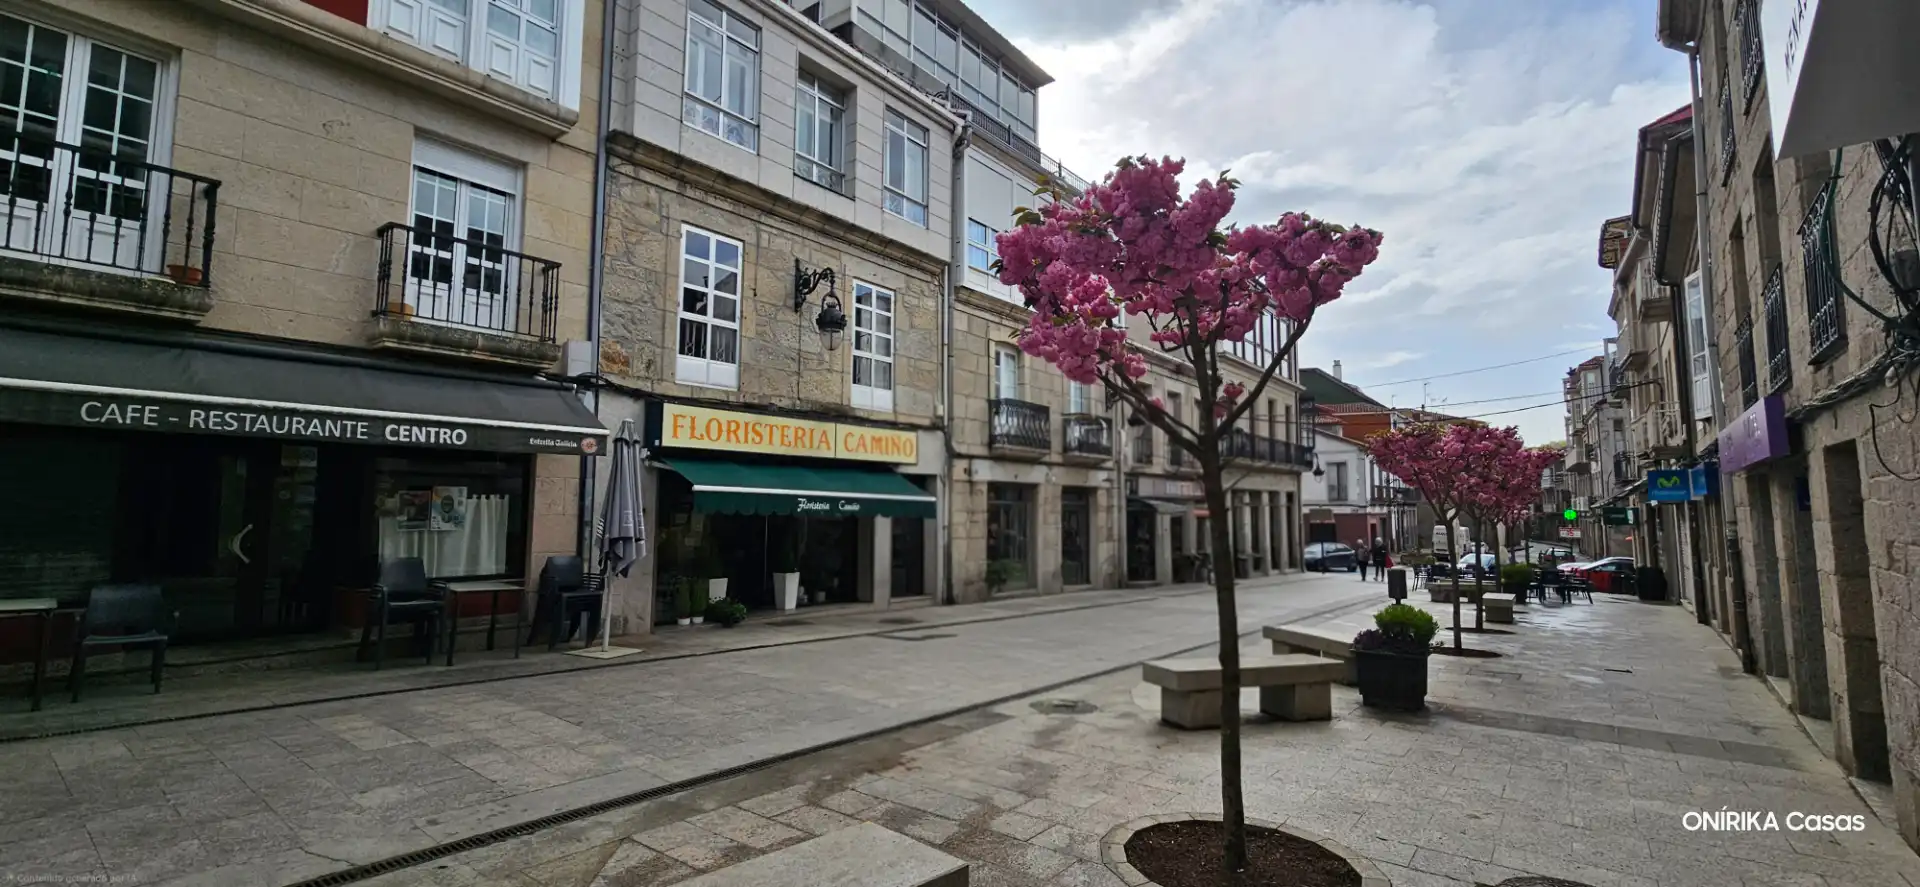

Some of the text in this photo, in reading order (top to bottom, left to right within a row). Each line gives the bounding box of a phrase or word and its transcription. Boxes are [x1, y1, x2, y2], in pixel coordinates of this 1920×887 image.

[80, 401, 160, 426] CAFE
[189, 410, 369, 439] RESTAURANTE
[385, 424, 467, 445] CENTRO
[671, 413, 832, 451] FLORISTERIA
